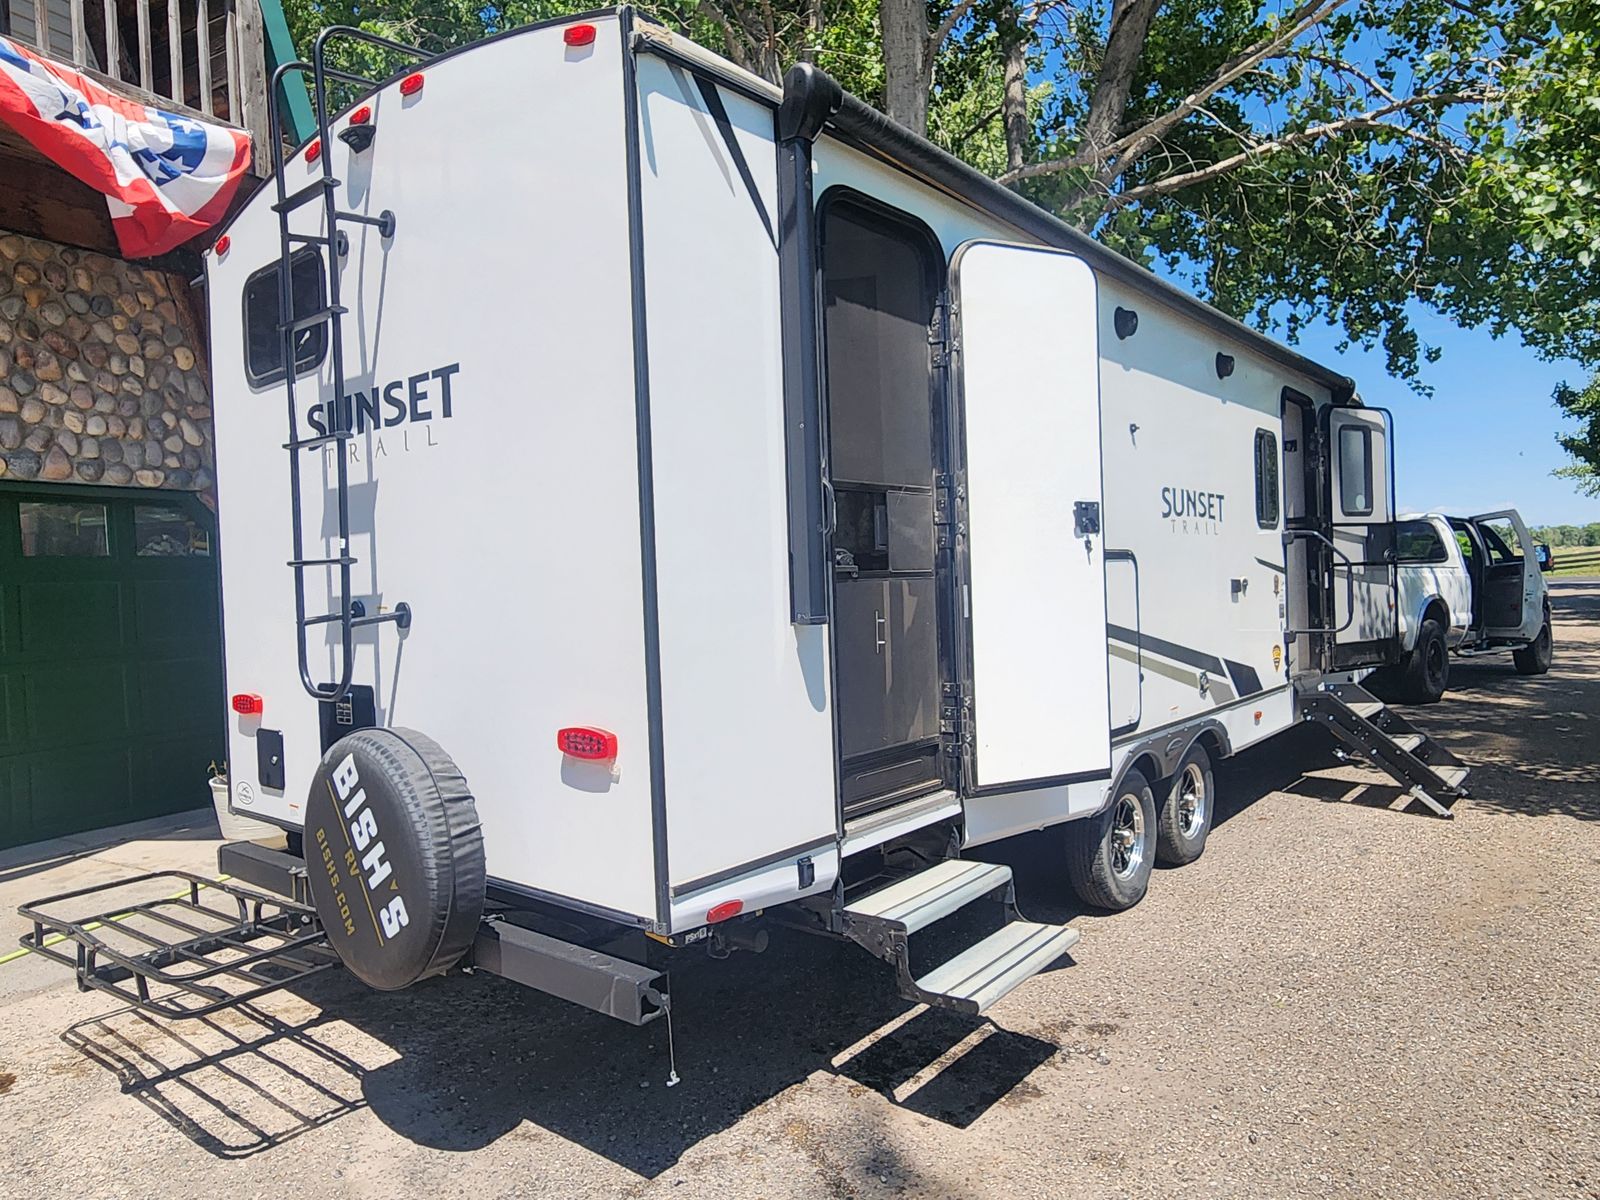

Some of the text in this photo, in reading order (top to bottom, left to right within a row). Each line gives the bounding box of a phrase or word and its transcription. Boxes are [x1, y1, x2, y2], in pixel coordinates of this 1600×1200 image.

[325, 424, 438, 468] TRAIL
[1161, 486, 1225, 523] SUNSET
[1170, 519, 1219, 535] TRAIL
[344, 848, 360, 877] RV
[316, 827, 357, 937] BISHS.COM
